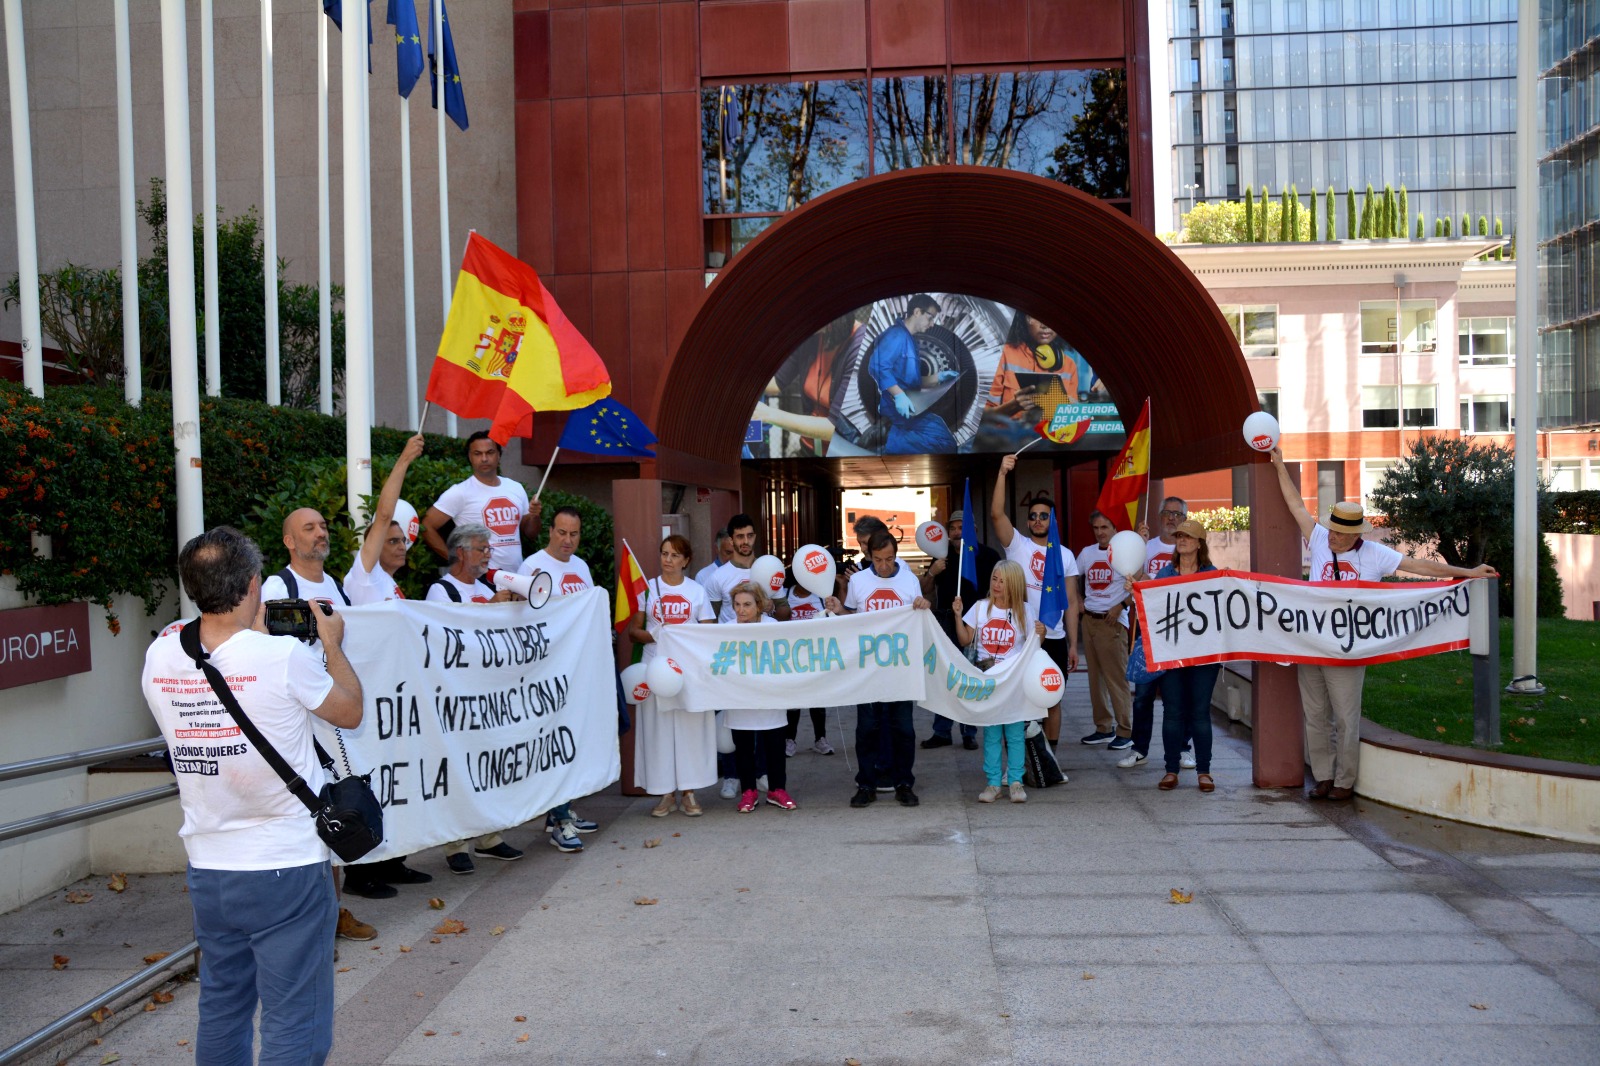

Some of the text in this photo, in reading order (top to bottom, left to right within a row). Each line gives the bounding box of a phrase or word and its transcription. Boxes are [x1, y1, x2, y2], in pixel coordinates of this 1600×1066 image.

[1057, 404, 1119, 414] AÑO EUROP
[486, 507, 519, 523] STOP
[926, 527, 941, 539] STOP
[805, 554, 825, 568] STOP
[1151, 560, 1172, 570] STO
[1088, 569, 1112, 580] STOP
[1325, 565, 1357, 581] SOP
[655, 602, 690, 615] STOP
[868, 598, 901, 611] STOP
[982, 626, 1015, 642] STOP
[0, 627, 79, 664] UROPEA
[421, 622, 550, 669] 1 DE OCTUBRE
[710, 637, 846, 676] #MARCHA
[858, 632, 911, 669] POR
[923, 642, 937, 675] A
[1043, 677, 1061, 686] STOP
[375, 681, 421, 740] DÍA
[205, 743, 248, 758] QUIERES
[175, 760, 217, 774] ESTAR TÚ?
[380, 761, 409, 810] DE
[420, 757, 448, 802] LA
